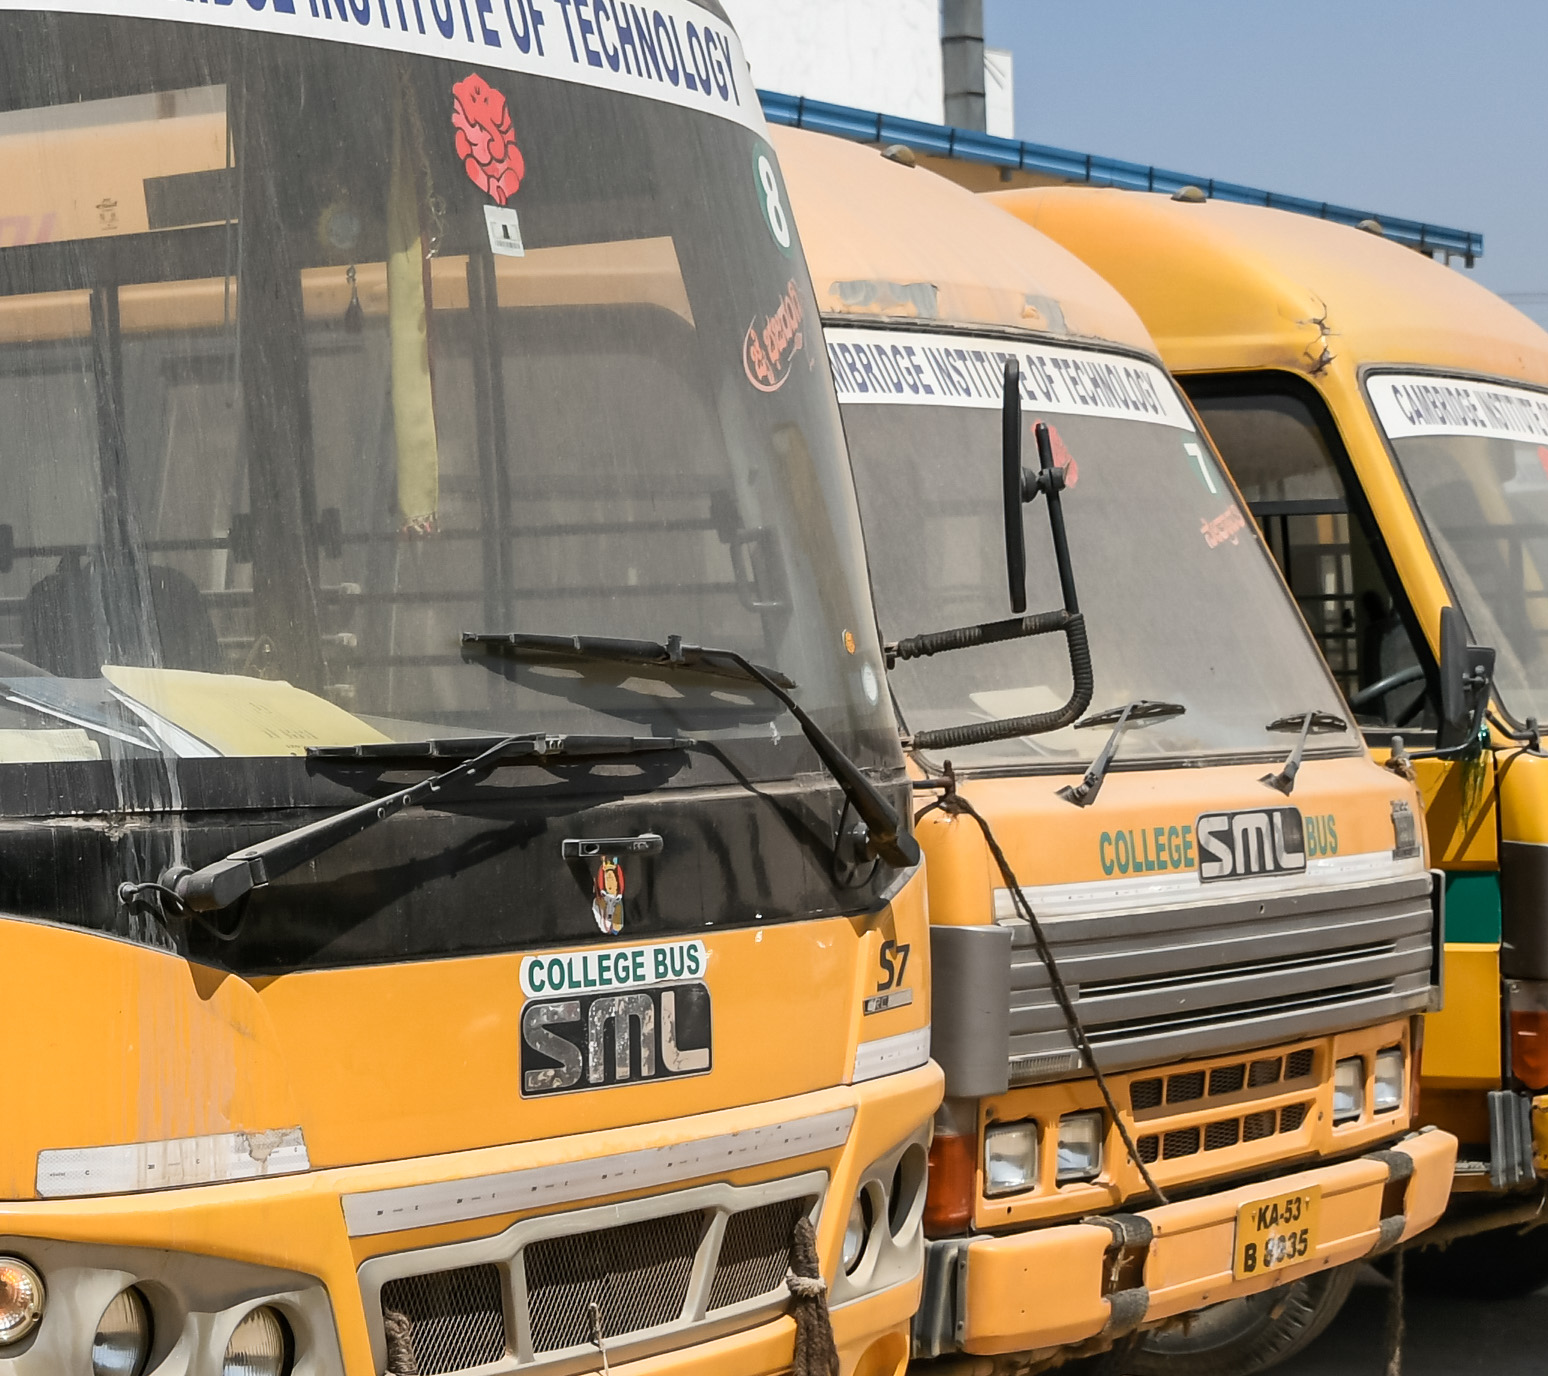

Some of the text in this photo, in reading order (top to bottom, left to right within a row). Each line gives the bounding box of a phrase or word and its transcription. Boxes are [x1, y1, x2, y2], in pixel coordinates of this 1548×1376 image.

[758, 155, 790, 248] 8
[1027, 355, 1060, 403] OF
[1050, 358, 1167, 417] TECHNOLOGY
[1183, 442, 1217, 494] 7
[1099, 825, 1194, 875] COLLEGE
[1304, 814, 1338, 857] BUS
[1198, 811, 1304, 877] SML
[528, 943, 700, 993] COLLEGE BUS
[877, 940, 911, 992] S7
[522, 990, 711, 1092] SML
[1257, 1196, 1302, 1232] KA-53
[1244, 1242, 1257, 1272] B
